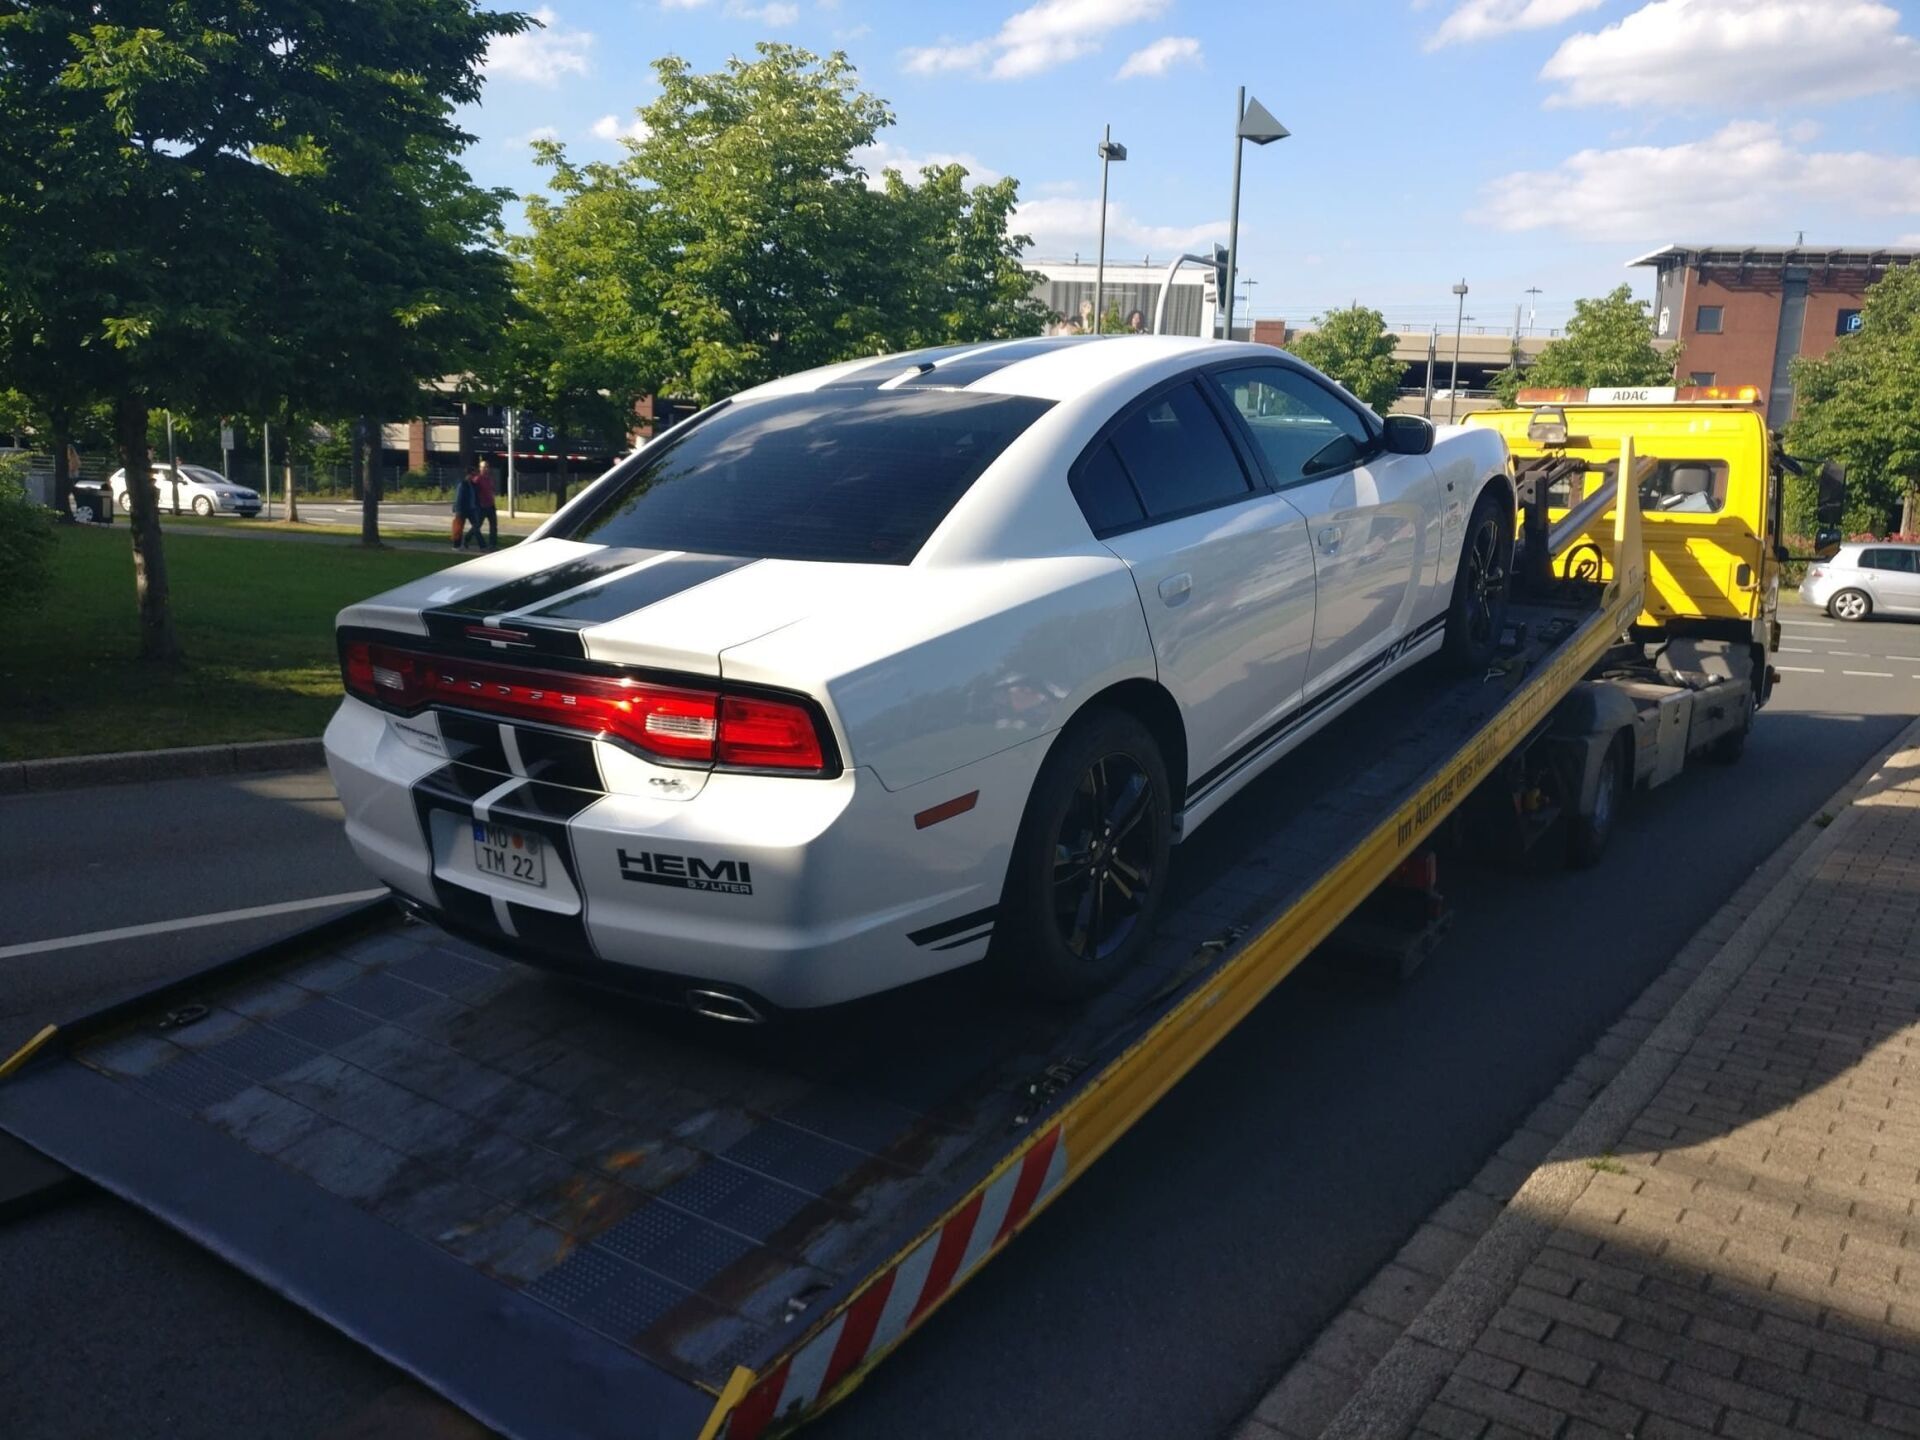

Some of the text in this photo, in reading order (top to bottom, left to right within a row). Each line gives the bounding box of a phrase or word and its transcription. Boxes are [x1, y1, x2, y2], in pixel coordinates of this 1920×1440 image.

[1612, 390, 1648, 401] ADAC
[483, 846, 534, 880] TM 22
[616, 848, 751, 883] HEMI
[687, 880, 750, 894] 5.7 LITER
